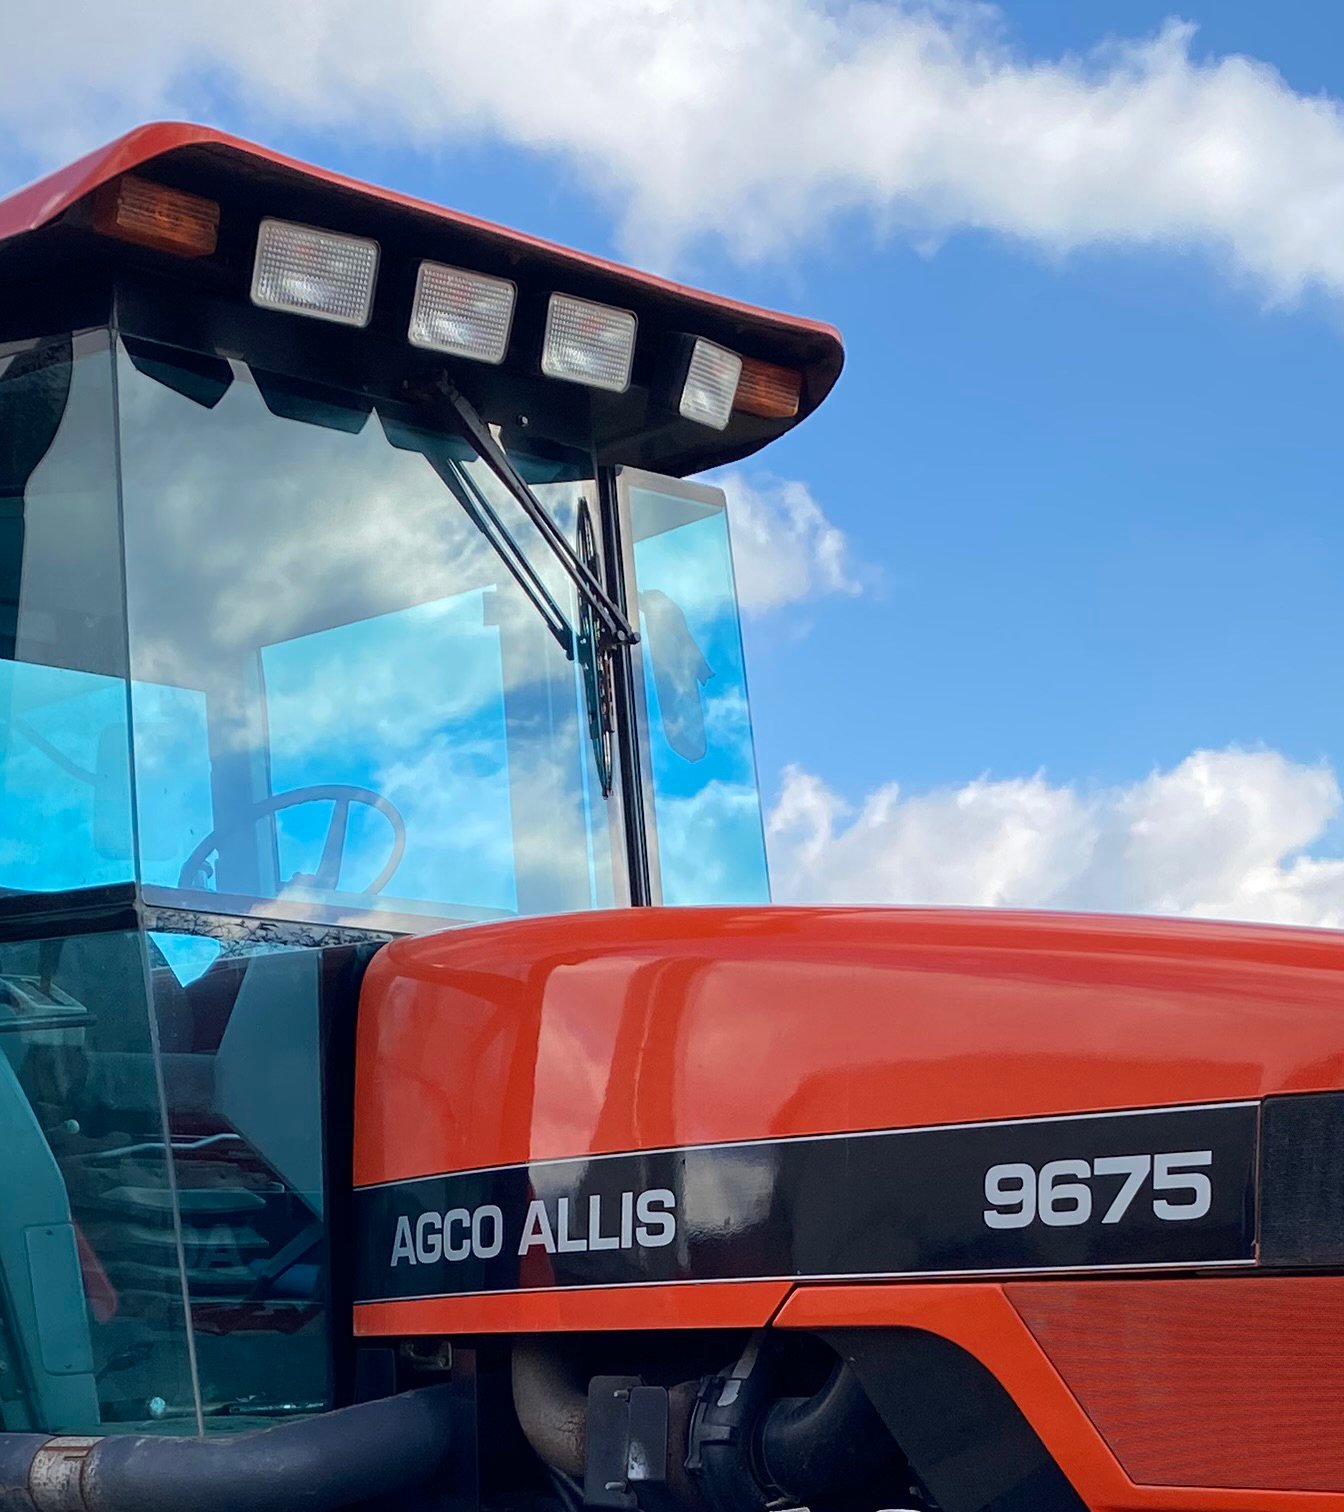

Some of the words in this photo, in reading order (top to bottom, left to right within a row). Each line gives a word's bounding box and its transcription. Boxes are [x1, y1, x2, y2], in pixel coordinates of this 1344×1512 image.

[390, 1205, 502, 1267] AGCO
[518, 1189, 676, 1255] ALLIS
[984, 1151, 1212, 1229] 9675
